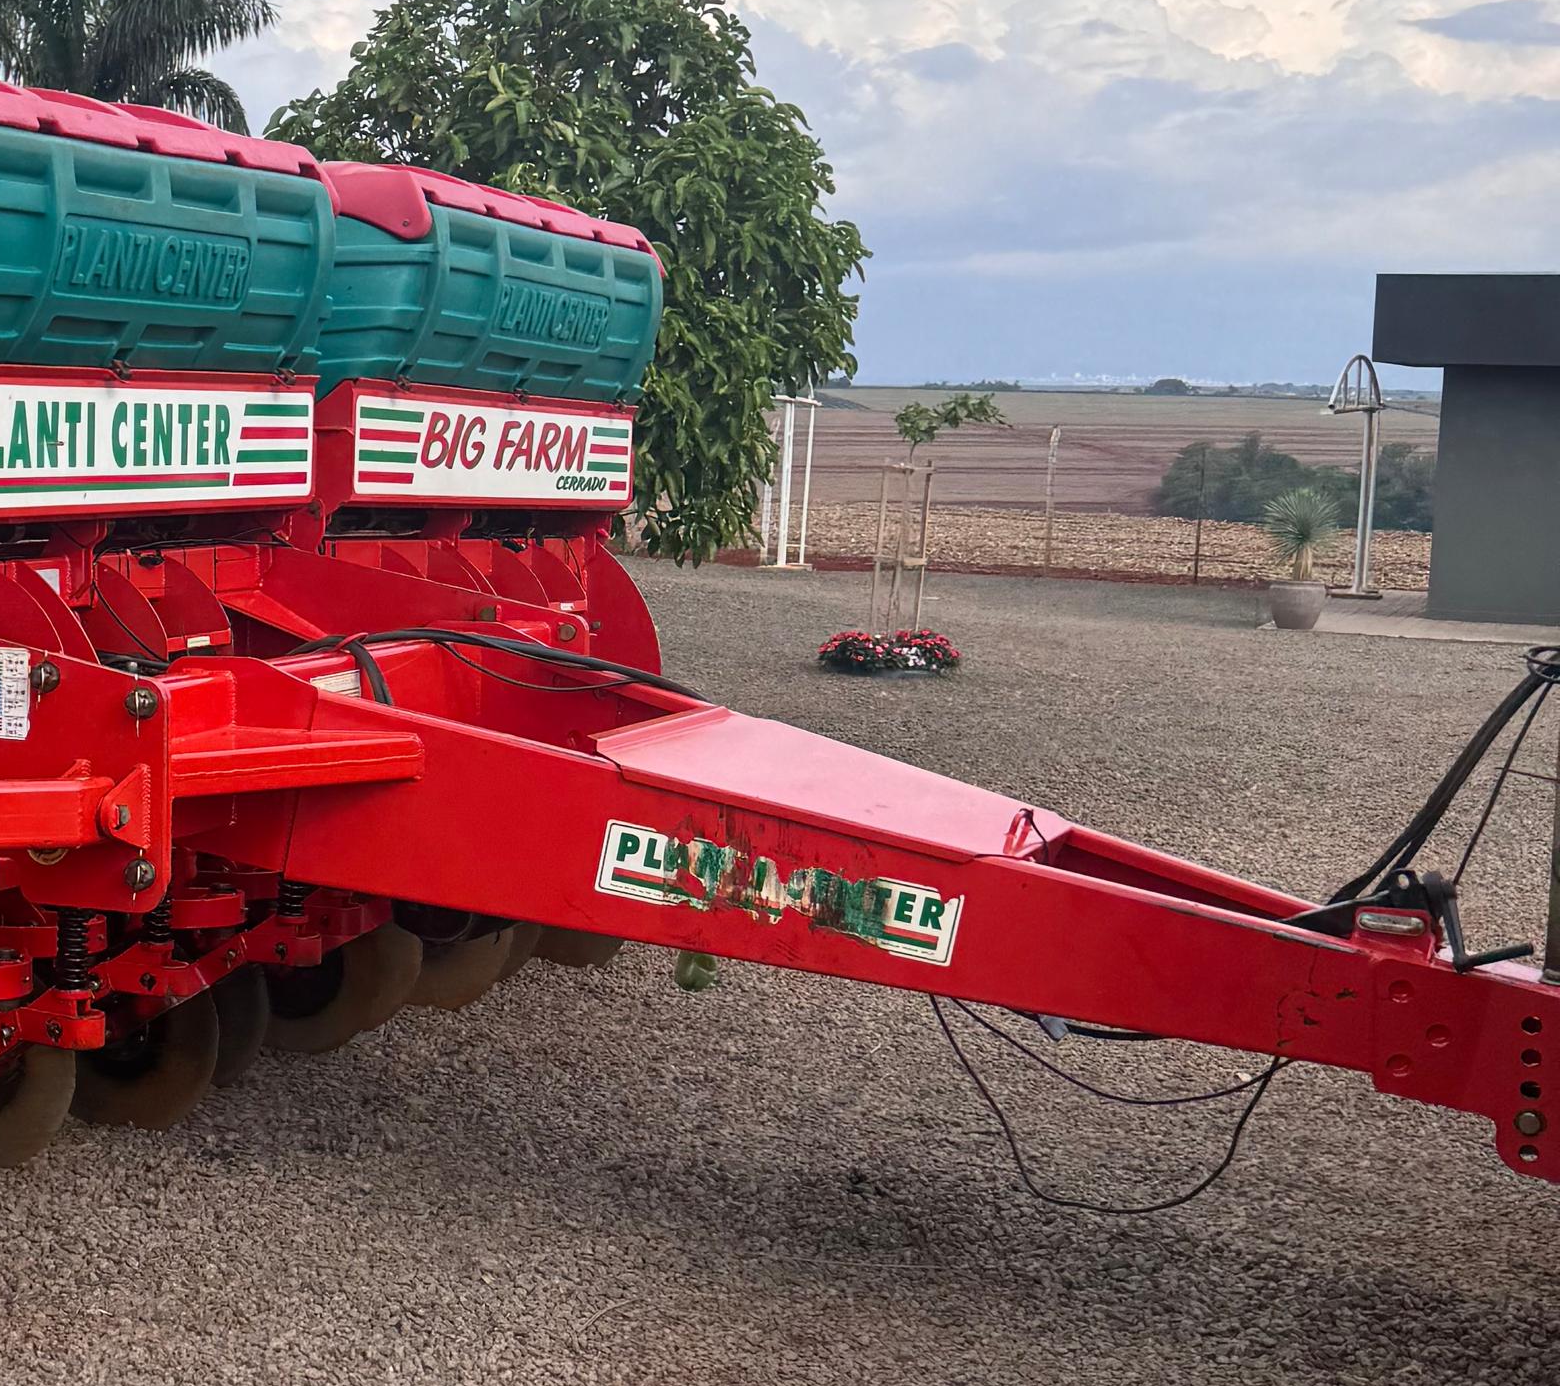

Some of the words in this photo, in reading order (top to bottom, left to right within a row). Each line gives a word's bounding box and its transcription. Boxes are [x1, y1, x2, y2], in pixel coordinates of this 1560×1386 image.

[55, 224, 155, 292] PLANTI
[156, 235, 250, 301] CENTER
[111, 401, 231, 469] CENTER
[420, 411, 487, 471] BIG
[493, 420, 589, 474] FARM
[555, 475, 608, 492] CERRADO
